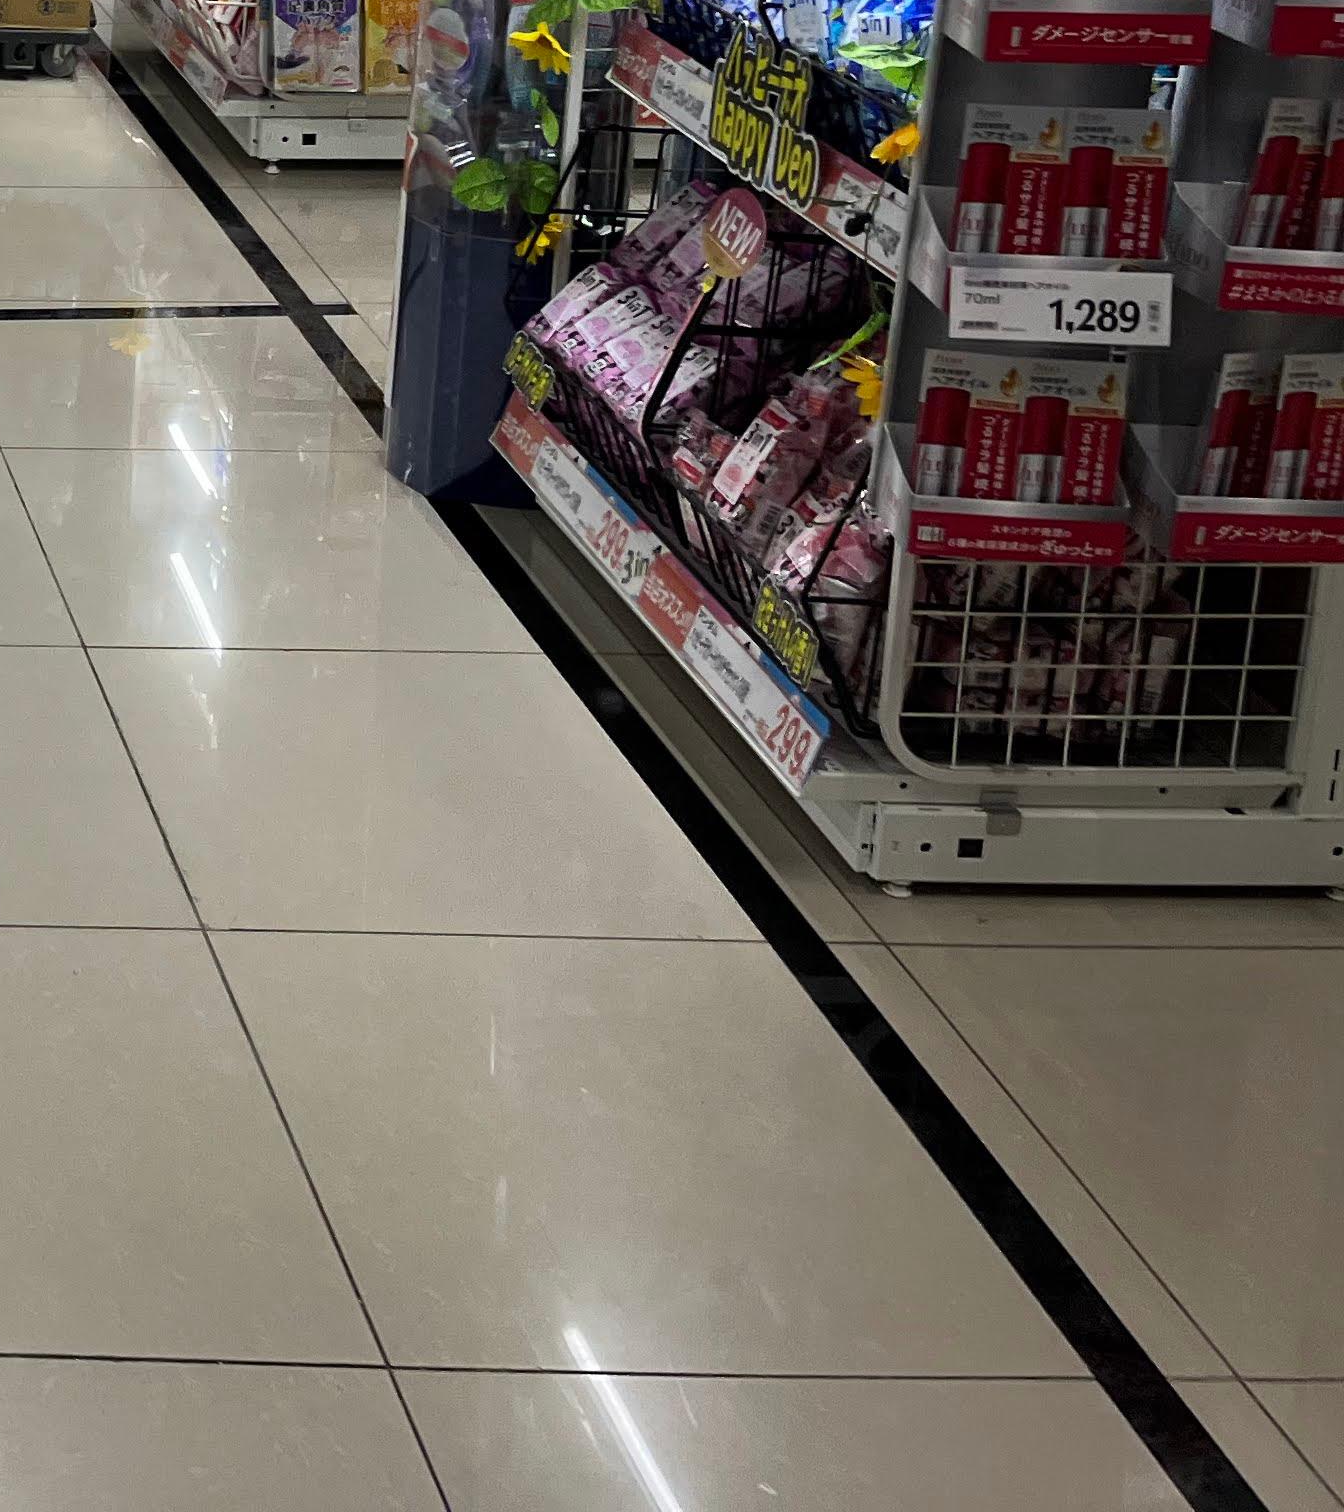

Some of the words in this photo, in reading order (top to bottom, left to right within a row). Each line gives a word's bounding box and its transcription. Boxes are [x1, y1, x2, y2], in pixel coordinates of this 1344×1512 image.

[712, 71, 770, 179] Happy
[710, 199, 763, 265] NEW!
[964, 292, 1000, 304] 70ml
[1049, 298, 1141, 334] 1,289
